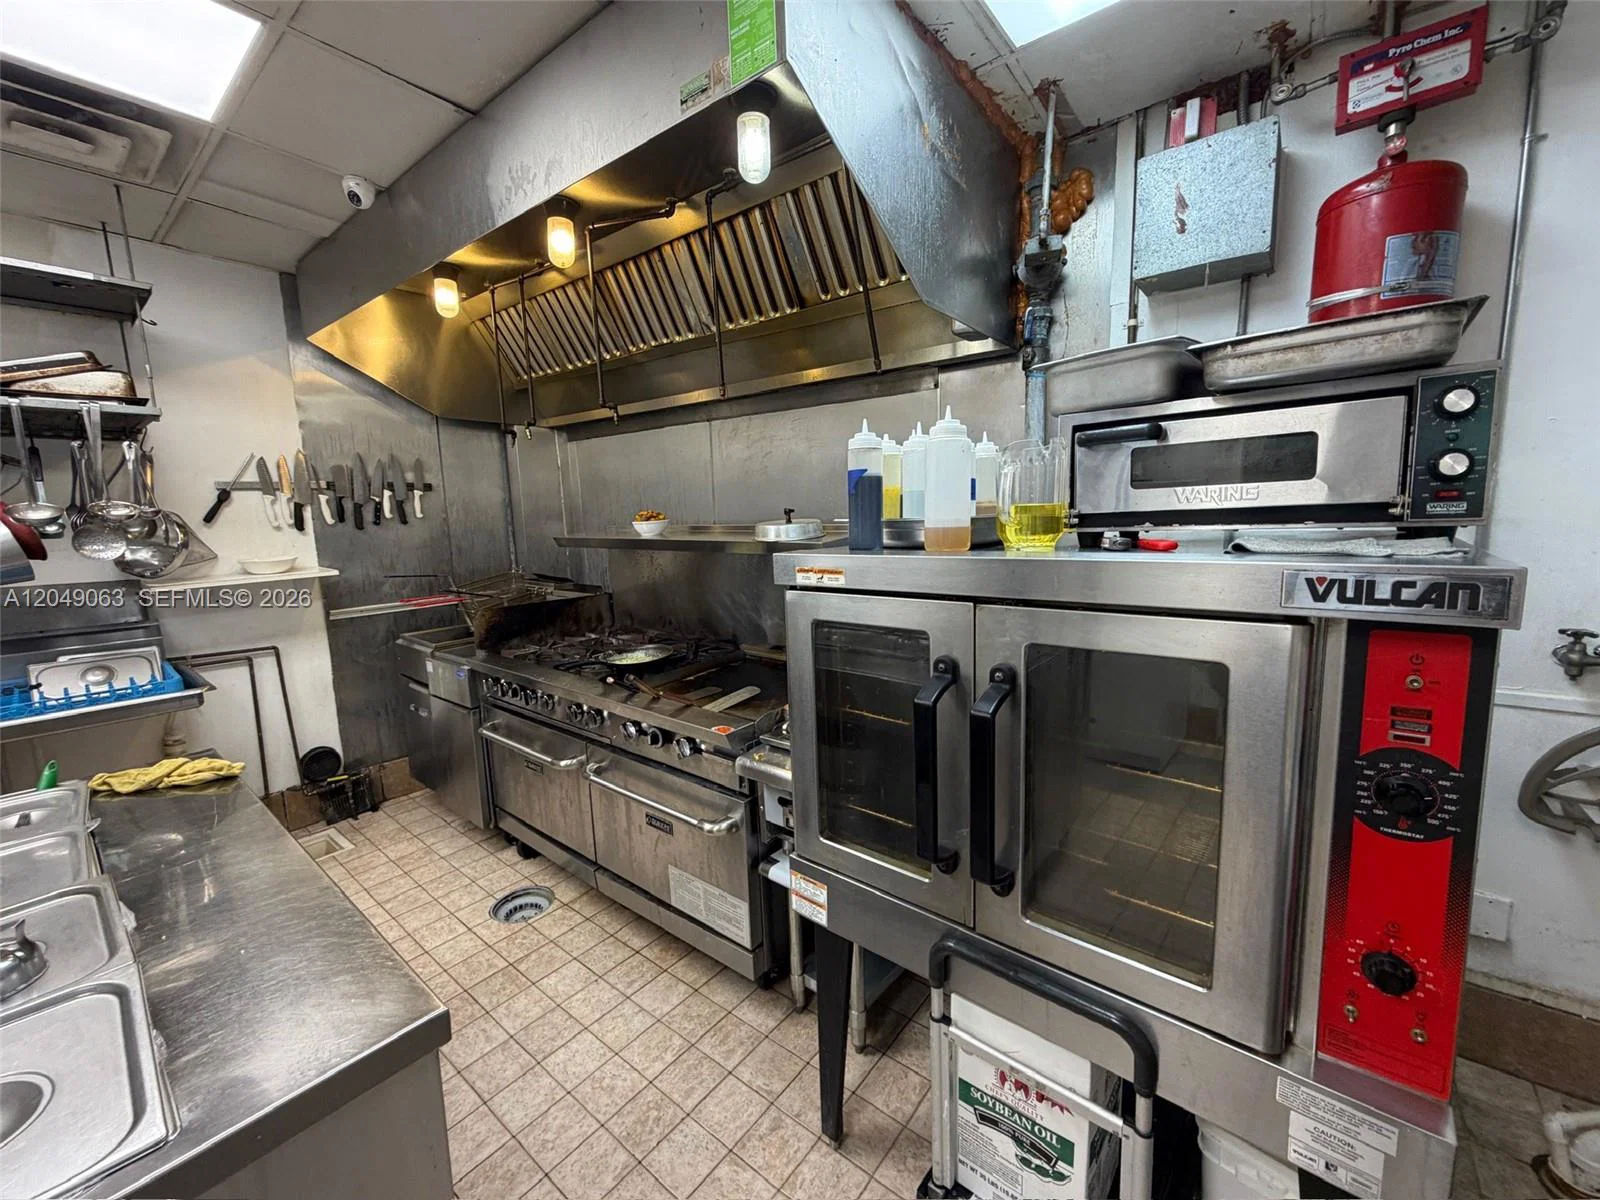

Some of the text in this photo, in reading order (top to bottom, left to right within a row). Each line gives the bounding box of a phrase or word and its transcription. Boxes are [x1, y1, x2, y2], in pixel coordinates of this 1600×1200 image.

[1388, 43, 1413, 57] Pyro
[1413, 33, 1442, 48] Chem
[1443, 26, 1464, 38] Inc.
[1173, 484, 1260, 507] WARING
[1428, 503, 1465, 511] WARING
[1305, 577, 1482, 611] VULCAN
[1379, 826, 1425, 840] THERMOSTAT
[970, 1087, 1033, 1131] SOYBEAN
[1034, 1123, 1061, 1149] OIL
